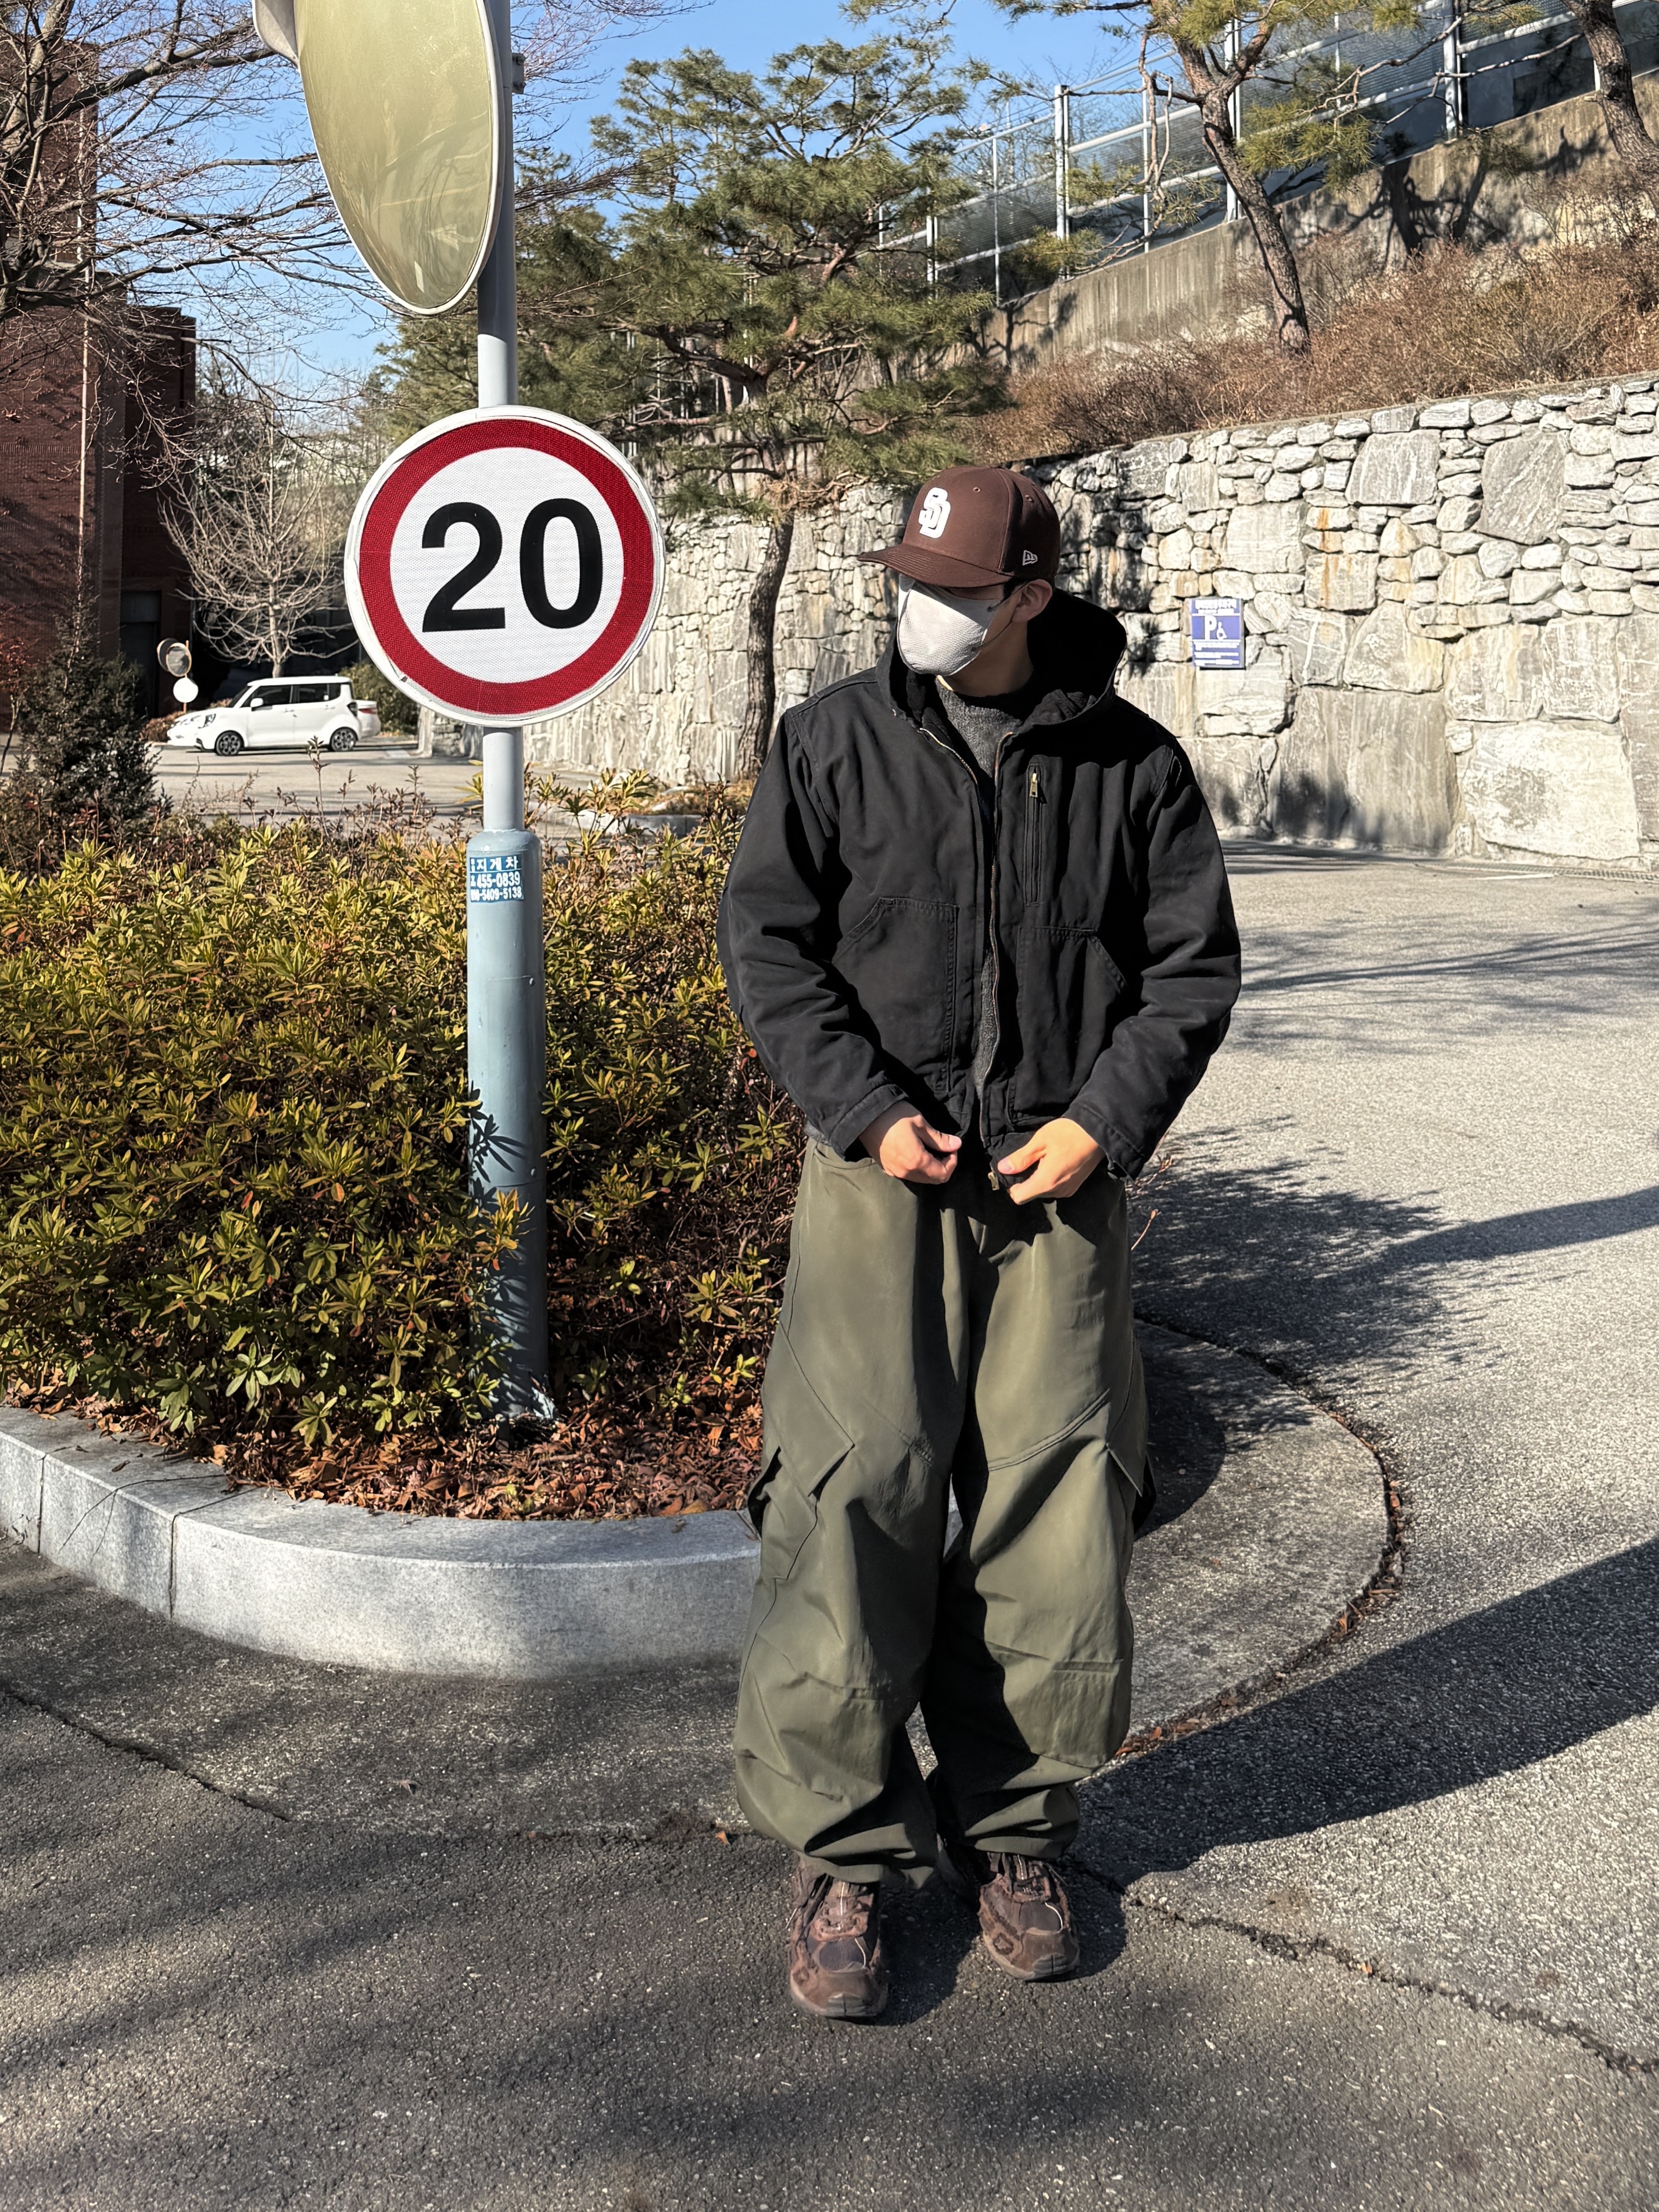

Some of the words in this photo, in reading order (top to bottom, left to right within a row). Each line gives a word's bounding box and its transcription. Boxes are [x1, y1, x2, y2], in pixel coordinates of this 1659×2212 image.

[918, 487, 951, 539] SD
[421, 498, 603, 633] 20
[1205, 615, 1217, 640] P
[476, 856, 518, 872] 지게차
[476, 871, 520, 888] 455-0839
